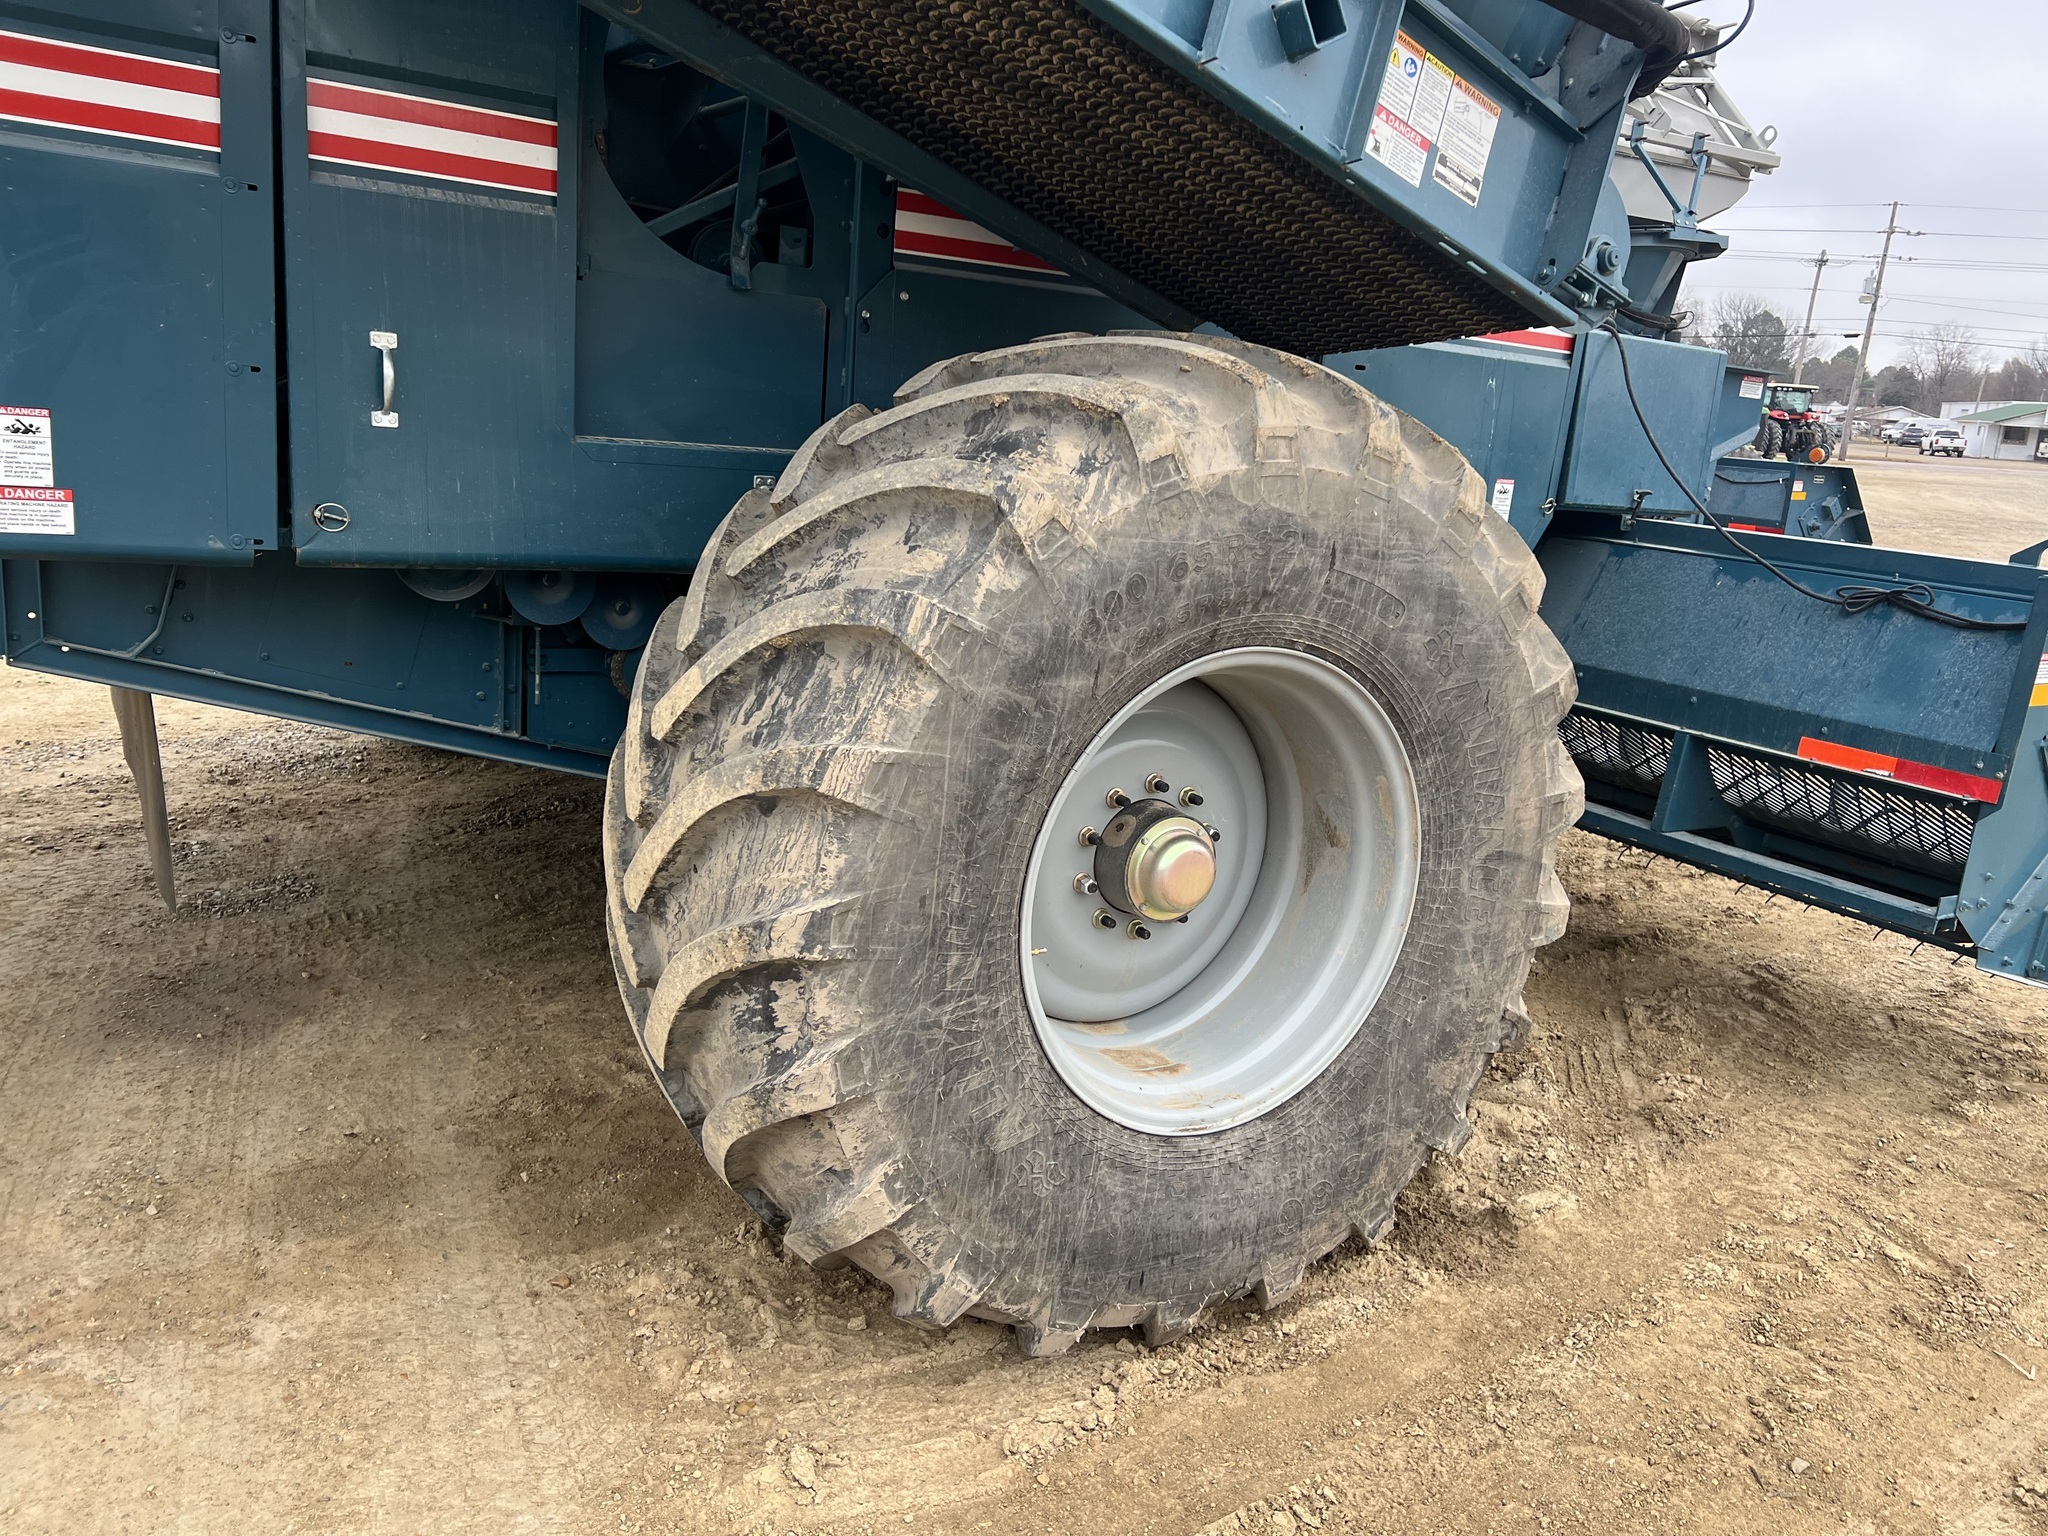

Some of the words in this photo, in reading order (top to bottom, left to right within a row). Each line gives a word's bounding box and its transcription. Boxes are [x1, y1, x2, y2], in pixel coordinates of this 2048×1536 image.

[1398, 33, 1424, 58] WARNING
[1430, 58, 1453, 79] CAUTION
[1464, 83, 1499, 117] WARNING
[1387, 115, 1422, 146] DANGER
[7, 407, 49, 417] DANGER
[4, 488, 65, 501] DANGER
[1436, 679, 1506, 926] ALLIANCE
